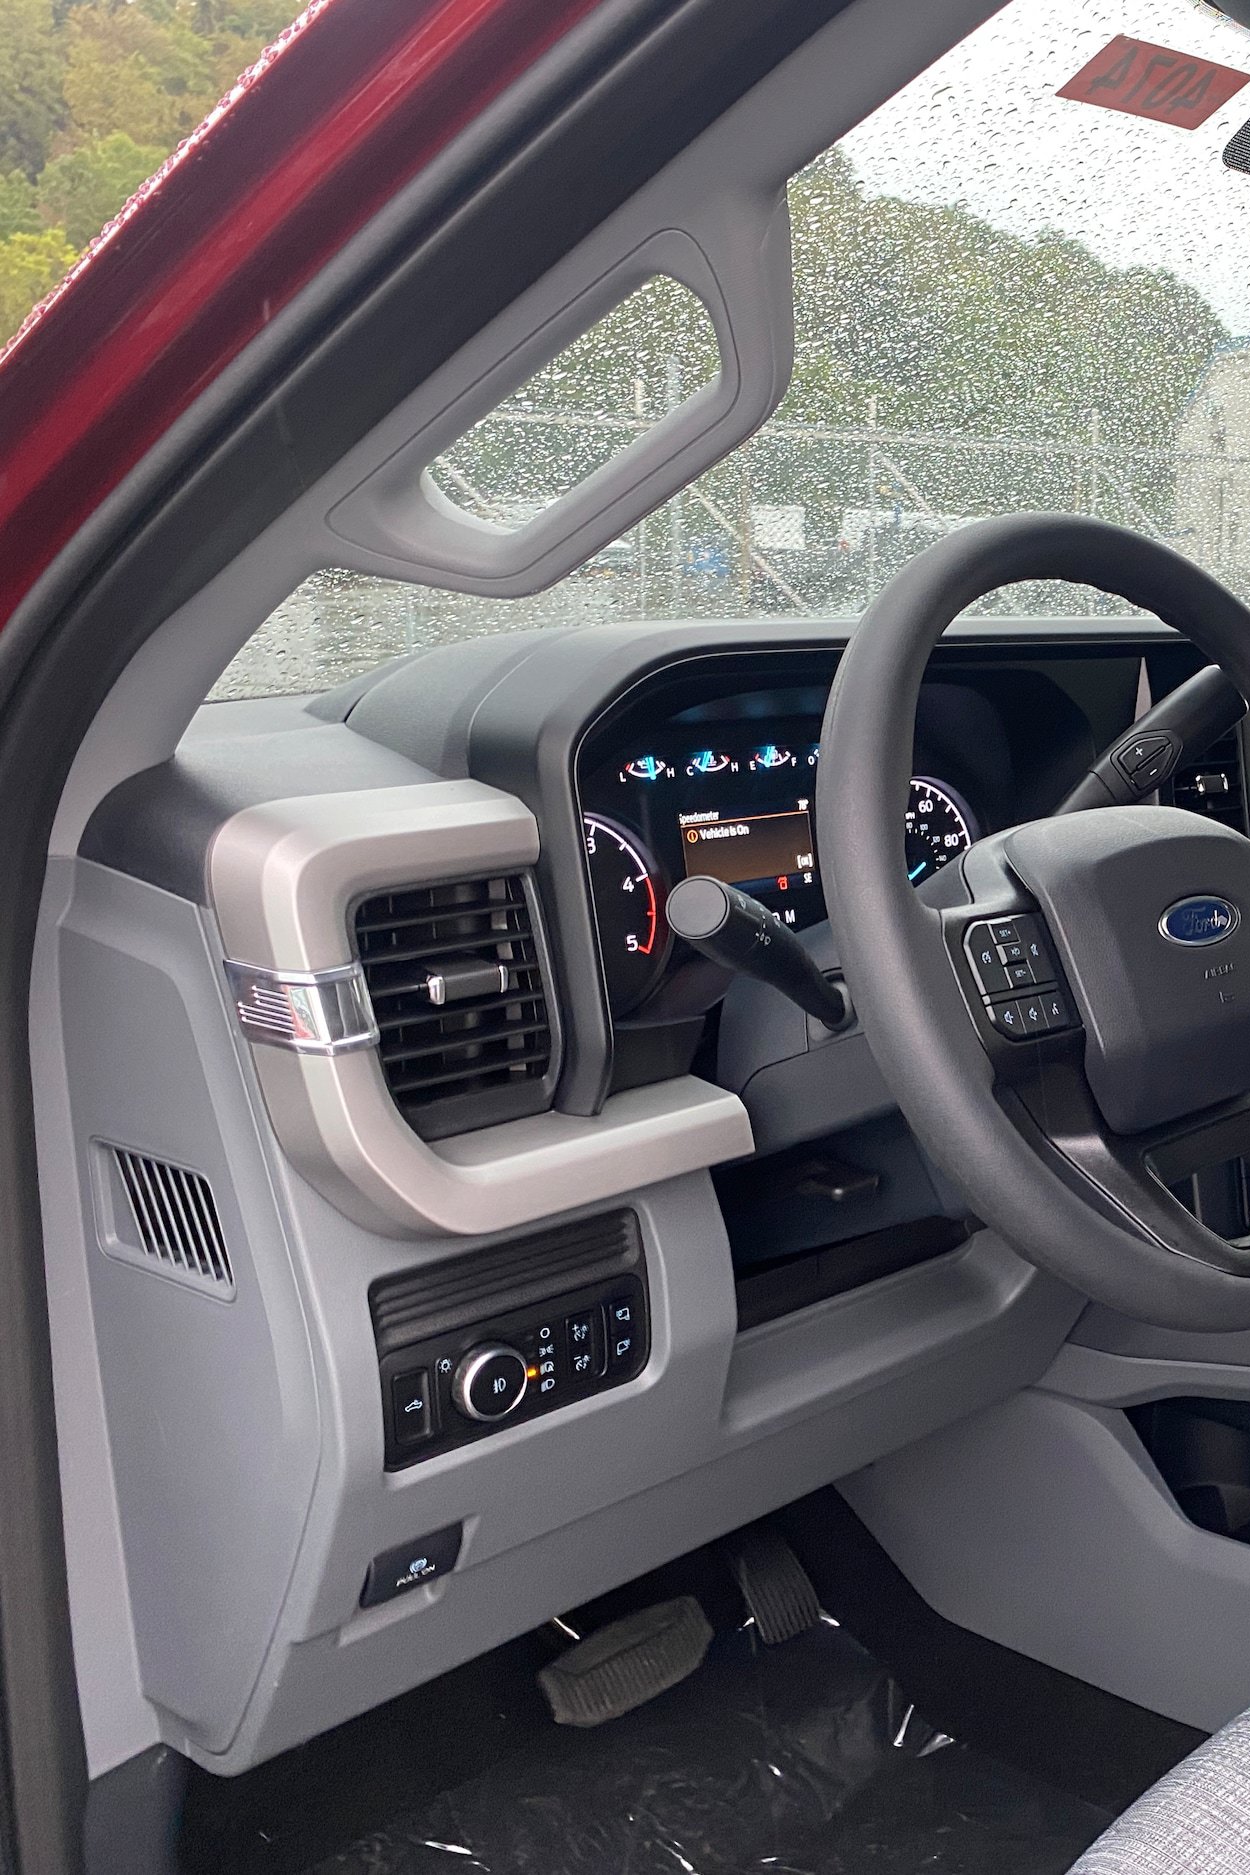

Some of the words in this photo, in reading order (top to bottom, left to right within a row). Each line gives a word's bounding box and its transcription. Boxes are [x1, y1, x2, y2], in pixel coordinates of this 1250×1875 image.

[686, 766, 695, 777] C
[731, 762, 739, 773] H
[749, 760, 757, 771] E
[791, 757, 797, 767] F
[619, 772, 627, 783] L
[666, 767, 676, 778] H
[918, 799, 934, 814] 60
[699, 827, 729, 840] Vehicle
[737, 825, 750, 836] On
[587, 837, 597, 855] 3
[944, 833, 959, 848] 80
[622, 876, 635, 893] 4
[784, 909, 796, 924] M
[1183, 906, 1222, 936] Ford
[626, 934, 639, 952] 5
